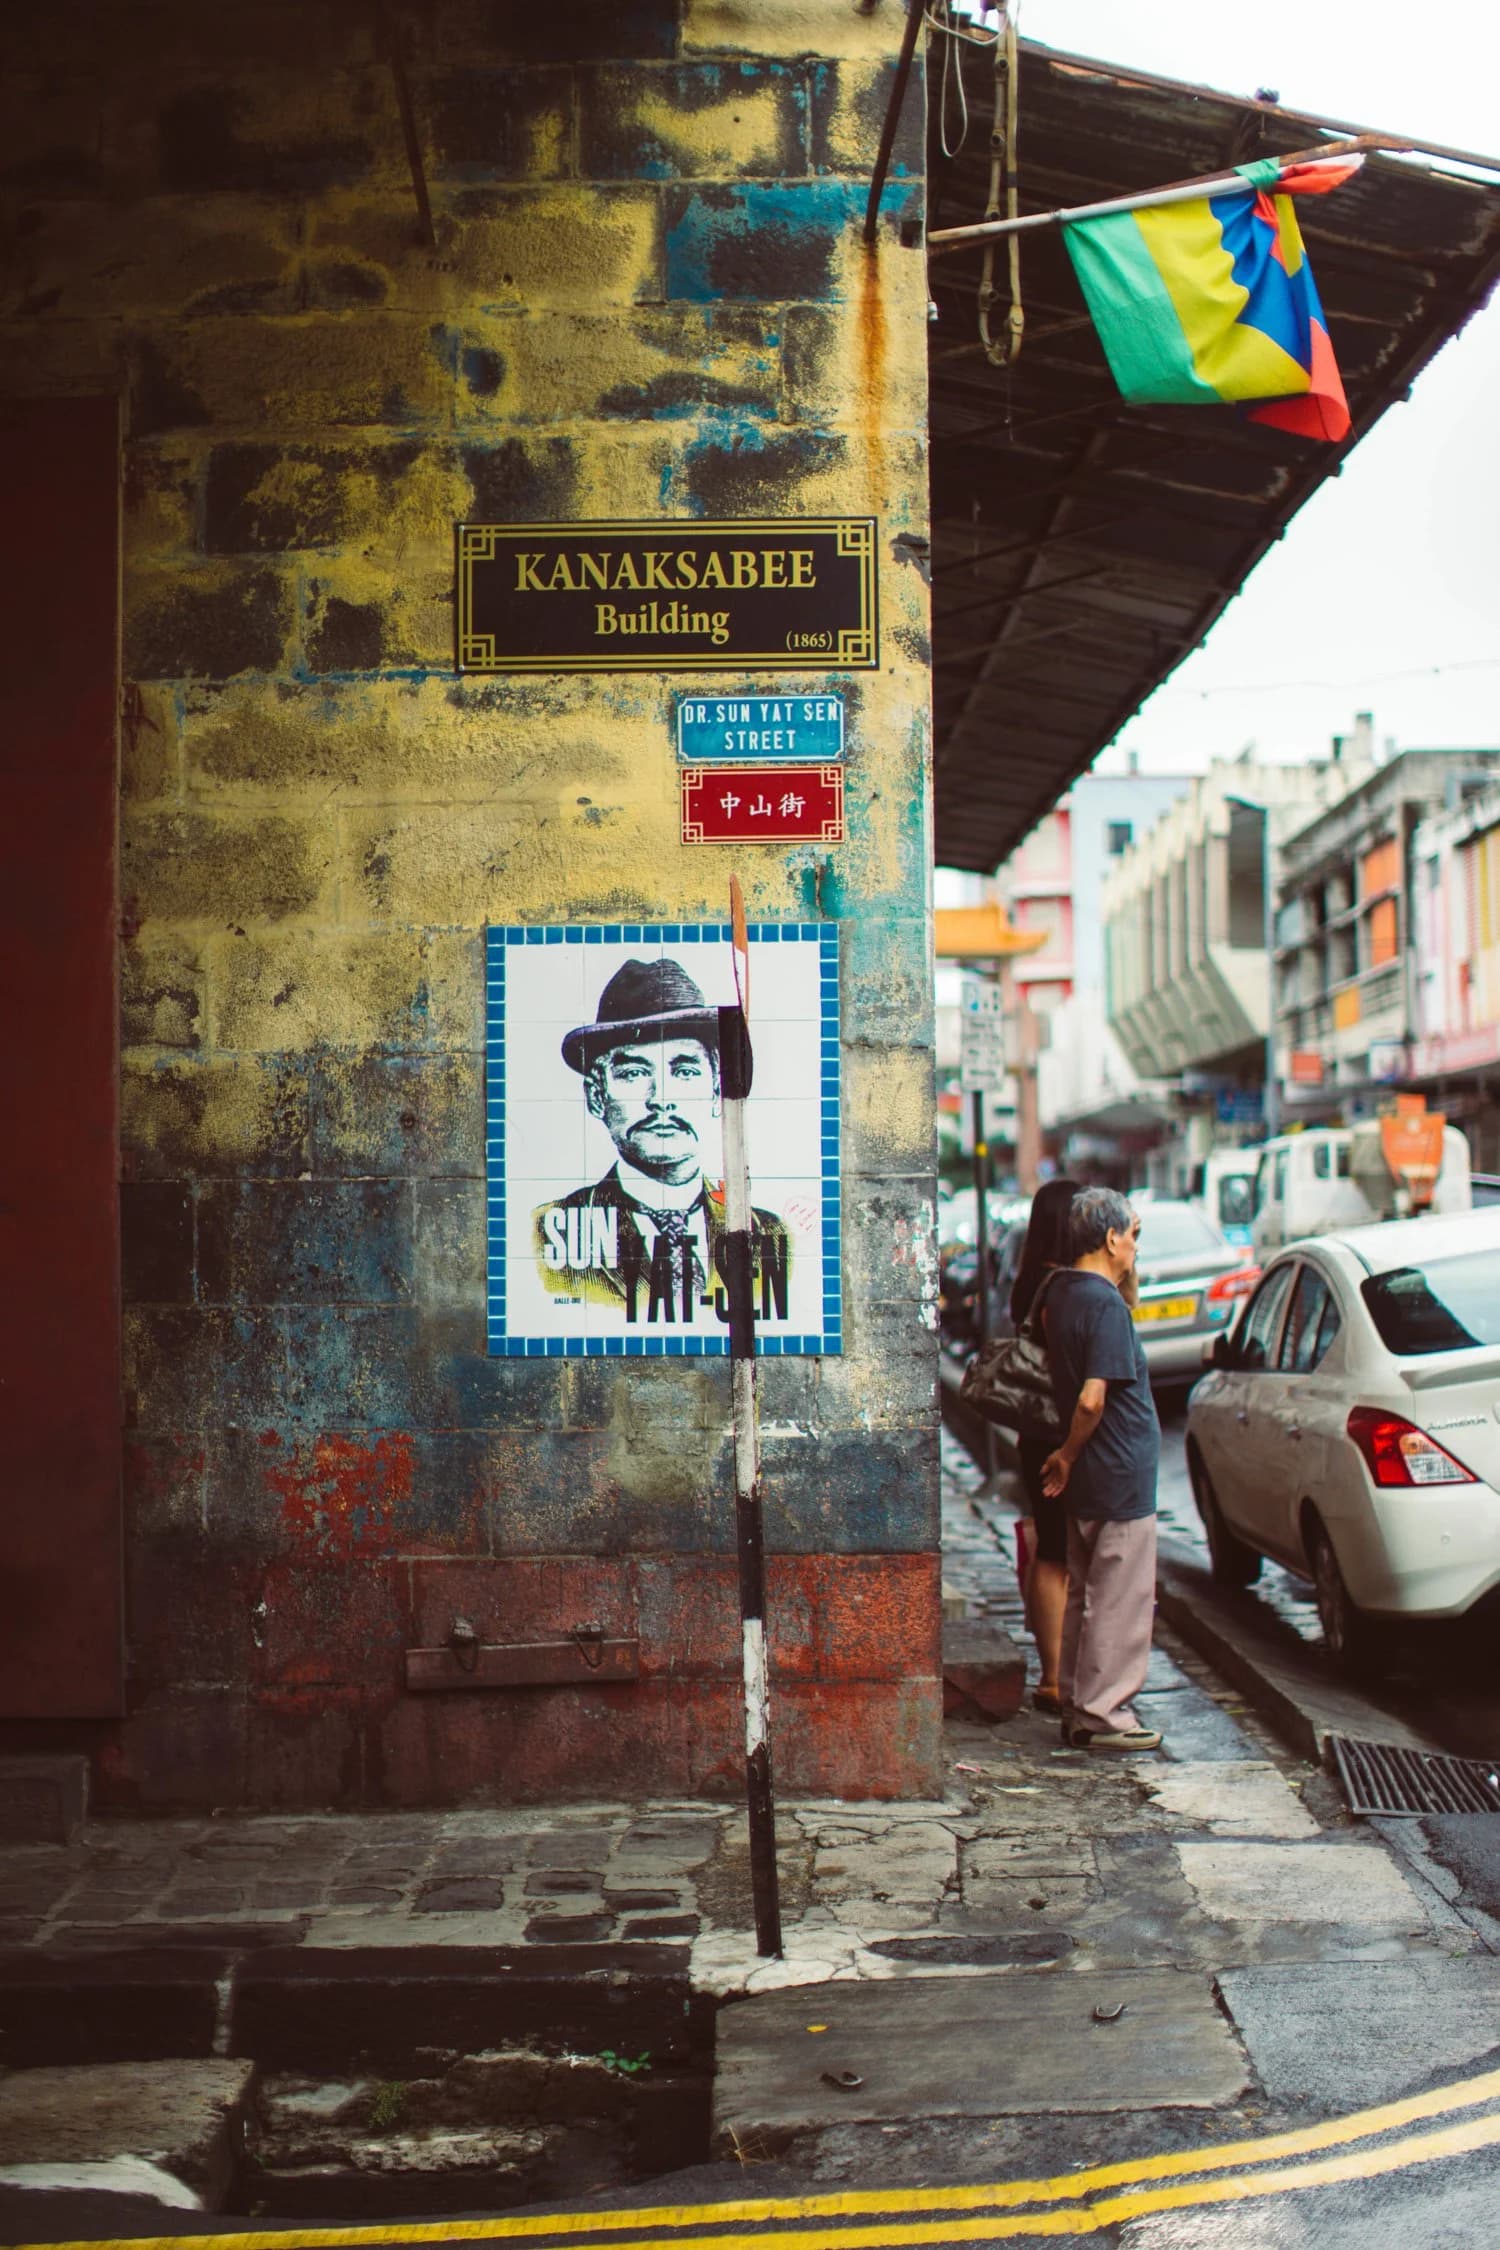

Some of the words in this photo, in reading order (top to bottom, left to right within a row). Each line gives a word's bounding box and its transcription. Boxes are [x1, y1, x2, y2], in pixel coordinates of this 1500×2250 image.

[514, 550, 817, 591] KANAKSABEE
[594, 601, 730, 645] Building
[786, 630, 833, 651] (1865)
[685, 704, 712, 724] DR.
[716, 704, 750, 723] SUN
[760, 703, 793, 722] YAT
[804, 702, 839, 721] SEN
[724, 730, 796, 750] STREET
[720, 791, 806, 819] 中山街
[543, 1206, 617, 1270] SUN
